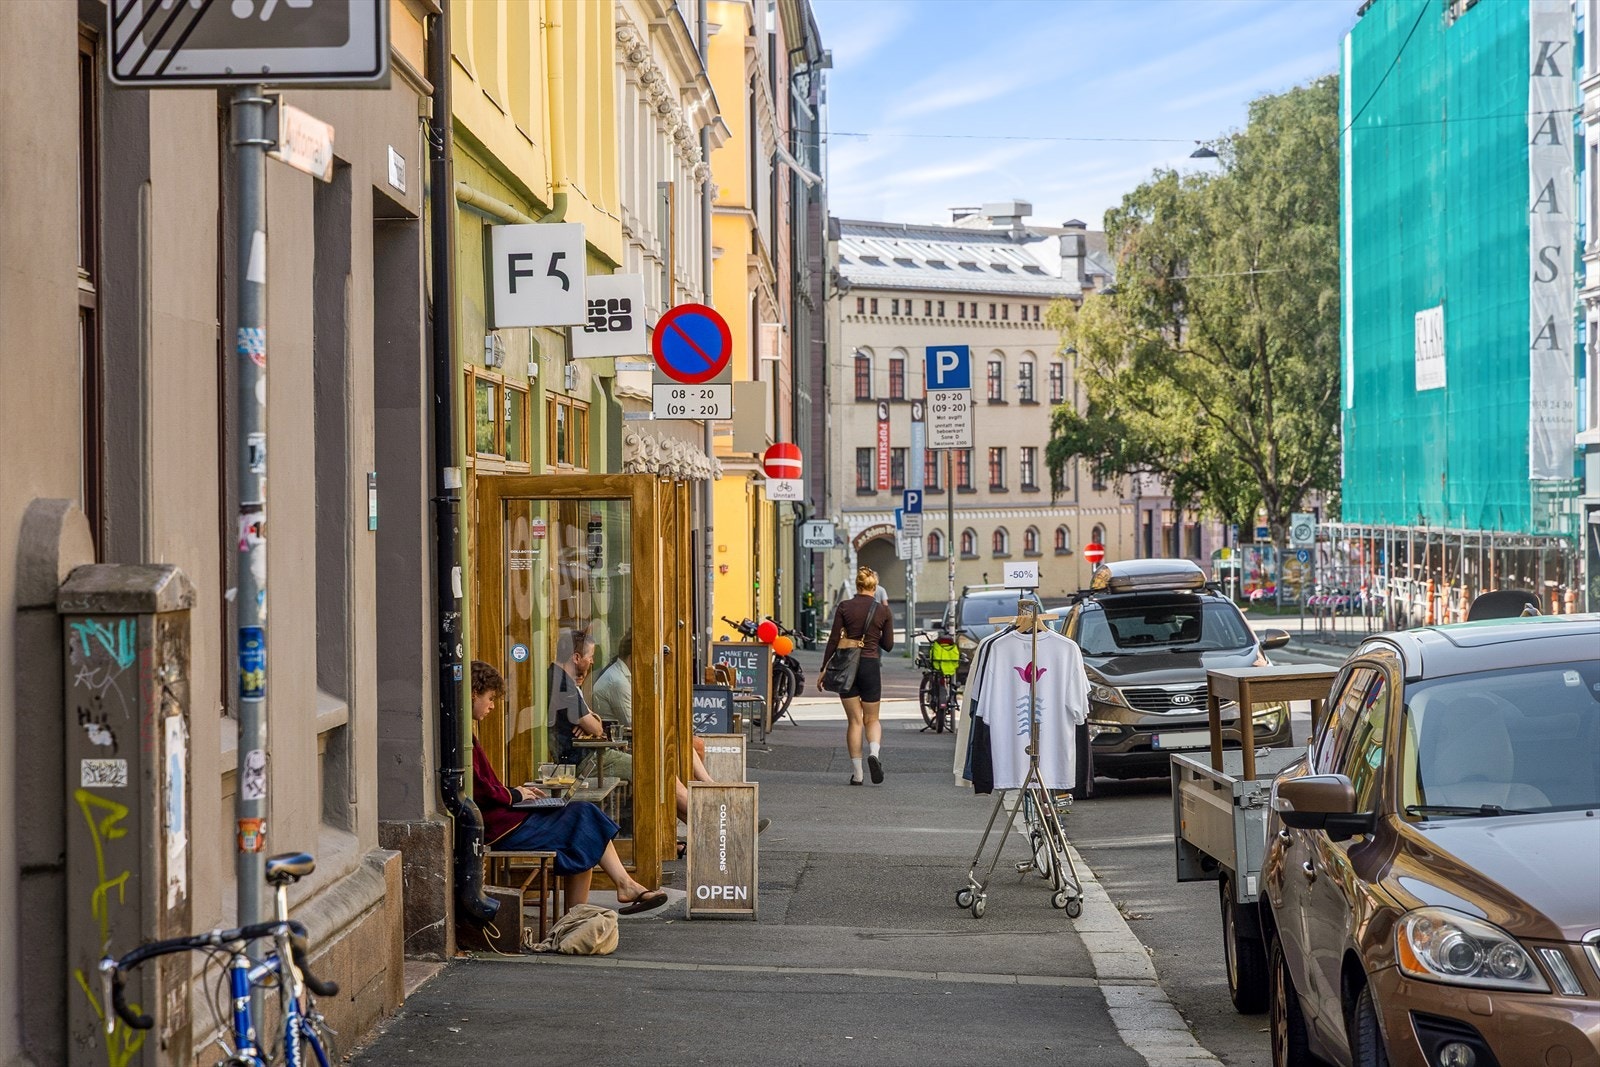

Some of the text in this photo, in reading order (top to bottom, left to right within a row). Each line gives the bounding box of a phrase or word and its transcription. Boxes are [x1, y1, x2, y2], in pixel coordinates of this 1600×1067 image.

[1530, 40, 1569, 351] KAASA
[936, 351, 959, 384] P
[672, 390, 686, 399] 08
[700, 390, 714, 399] 20
[667, 403, 686, 415] (09
[700, 403, 719, 415] 20)
[879, 423, 888, 487] POPSENTERET
[907, 492, 918, 511] P
[1010, 570, 1033, 578] -50%
[719, 656, 758, 669] RULE
[693, 696, 727, 709] MATIC
[719, 804, 727, 872] COLLECTIONS
[696, 885, 747, 900] OPEN
